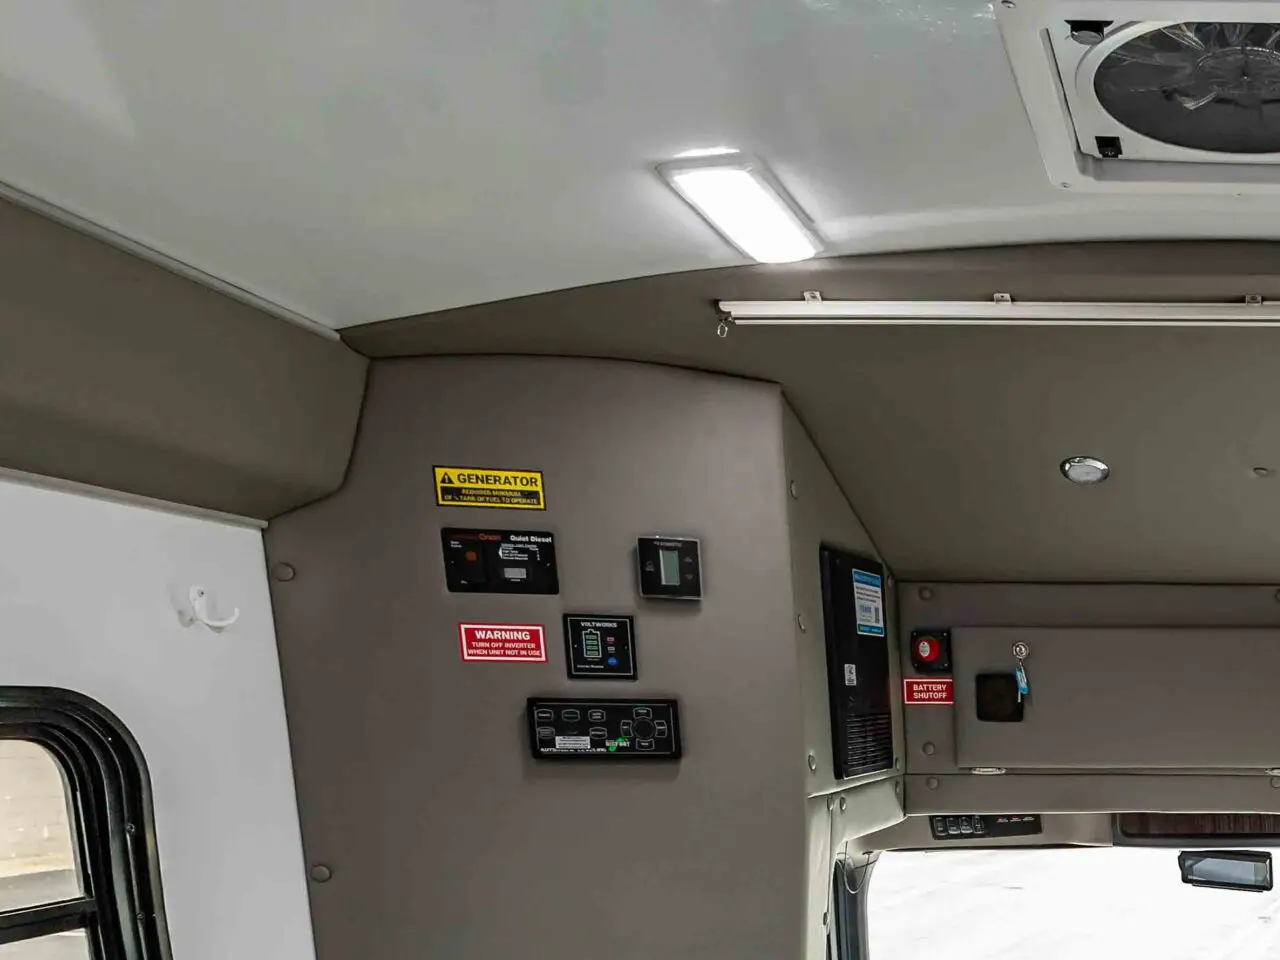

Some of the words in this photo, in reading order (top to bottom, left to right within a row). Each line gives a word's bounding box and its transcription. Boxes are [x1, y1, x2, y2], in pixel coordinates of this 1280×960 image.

[457, 472, 539, 487] GENERATOR
[511, 497, 538, 505] OPERATE
[510, 534, 529, 542] Quiet
[530, 535, 552, 543] Diesel
[474, 630, 531, 640] WARNING
[912, 683, 947, 691] BATTERY
